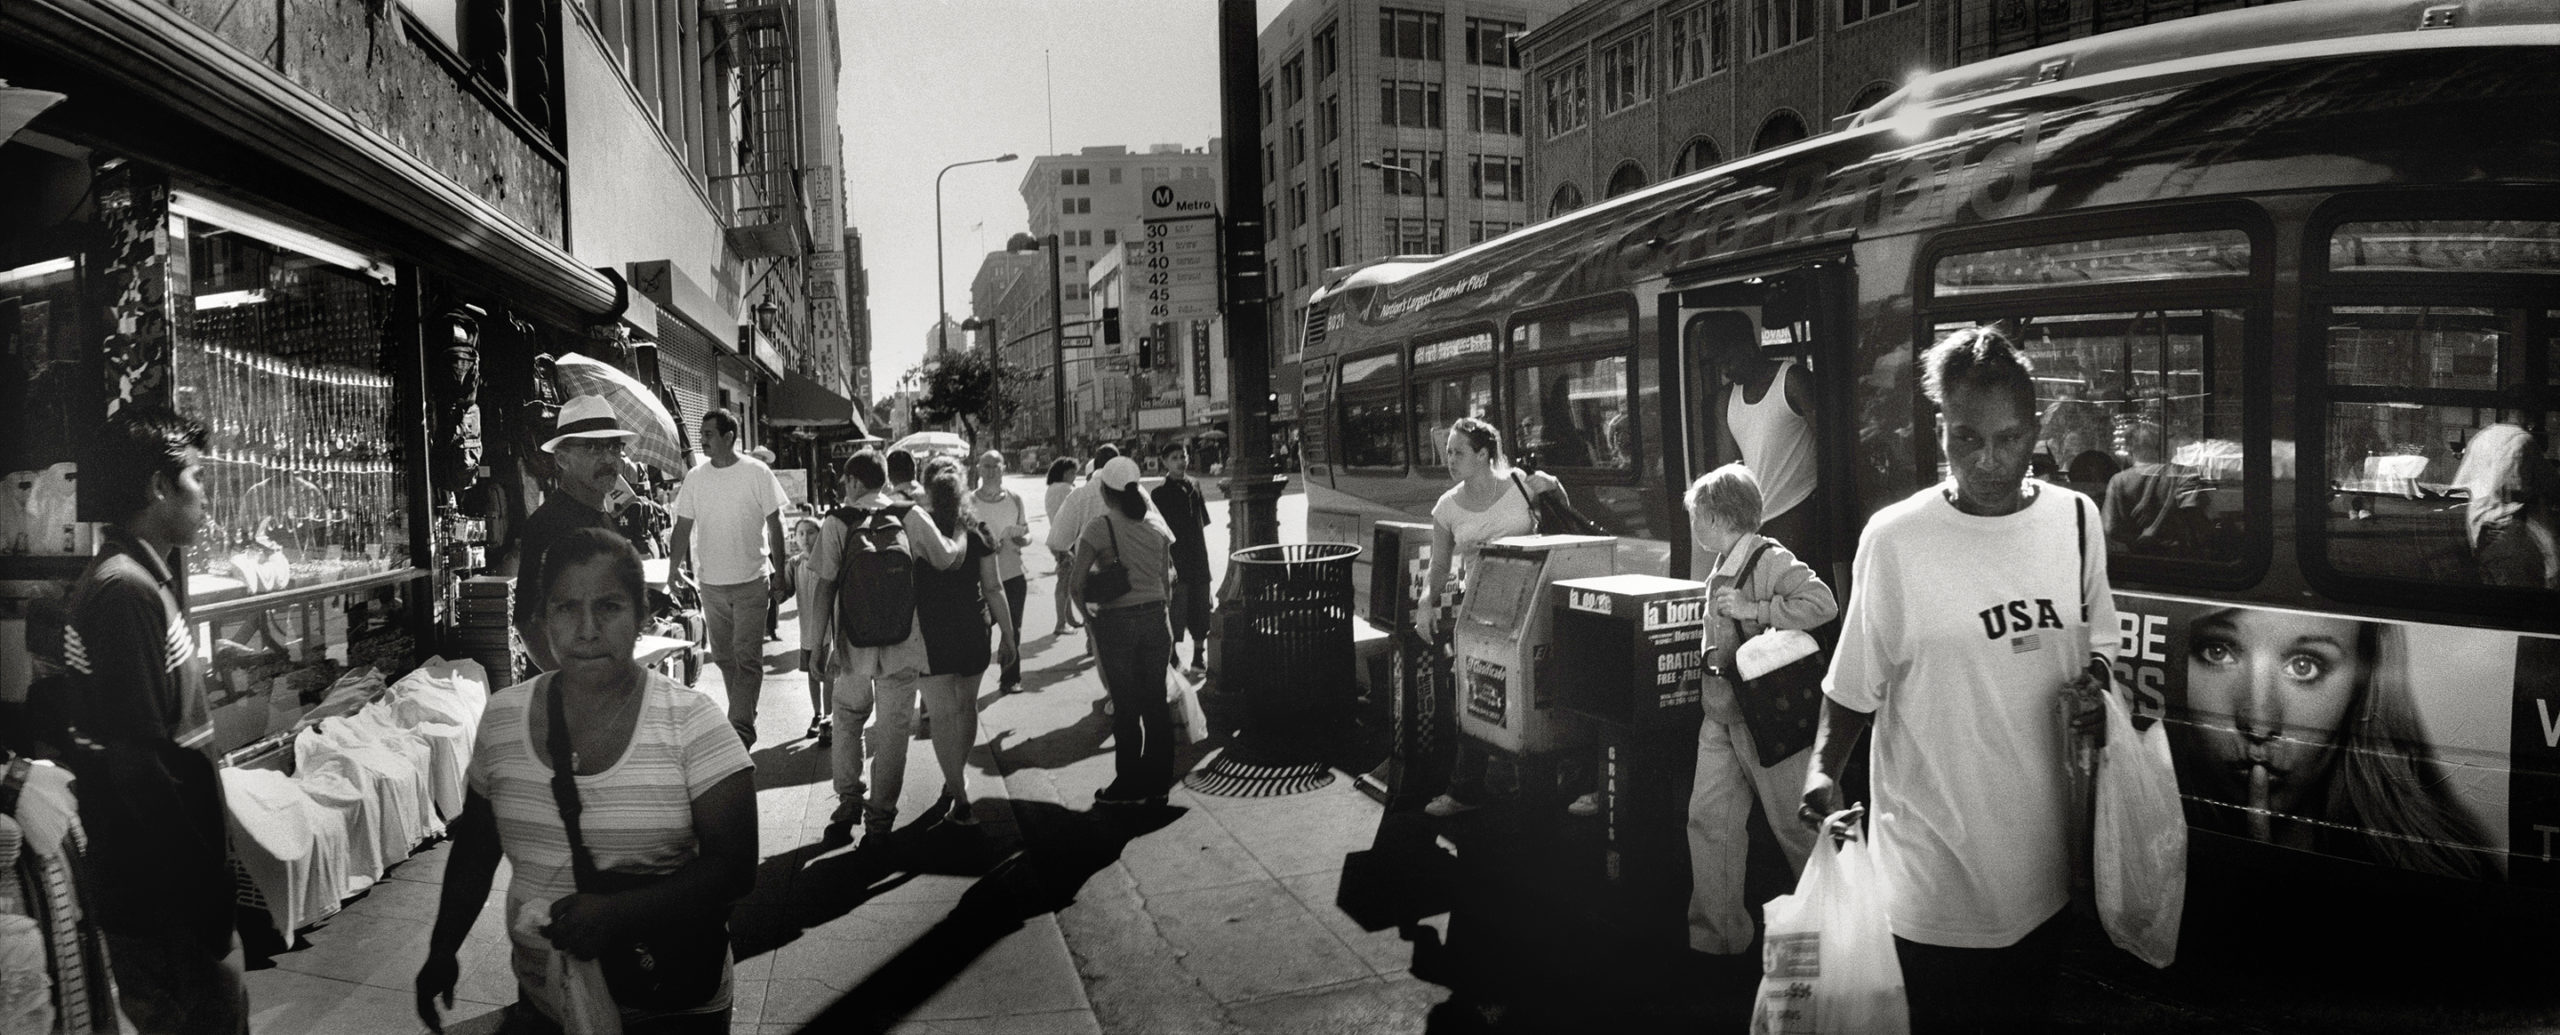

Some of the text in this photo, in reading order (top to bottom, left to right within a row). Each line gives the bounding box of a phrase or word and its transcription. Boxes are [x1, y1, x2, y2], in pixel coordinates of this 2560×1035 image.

[1177, 201, 1211, 212] Metro
[1147, 224, 1168, 238] 30
[1147, 241, 1164, 254] 31
[1148, 256, 1169, 270] 40
[1149, 272, 1168, 285] 42
[1149, 288, 1170, 301] 45
[1380, 301, 1406, 319] Nation's
[1406, 291, 1433, 312] Largest
[1466, 271, 1490, 292] Fleet
[1150, 303, 1169, 317] 46
[1979, 598, 2065, 640] USA
[1658, 650, 1701, 672] GRATIS
[1657, 671, 1676, 686] FREE
[1608, 746, 1616, 841] GRATIS
